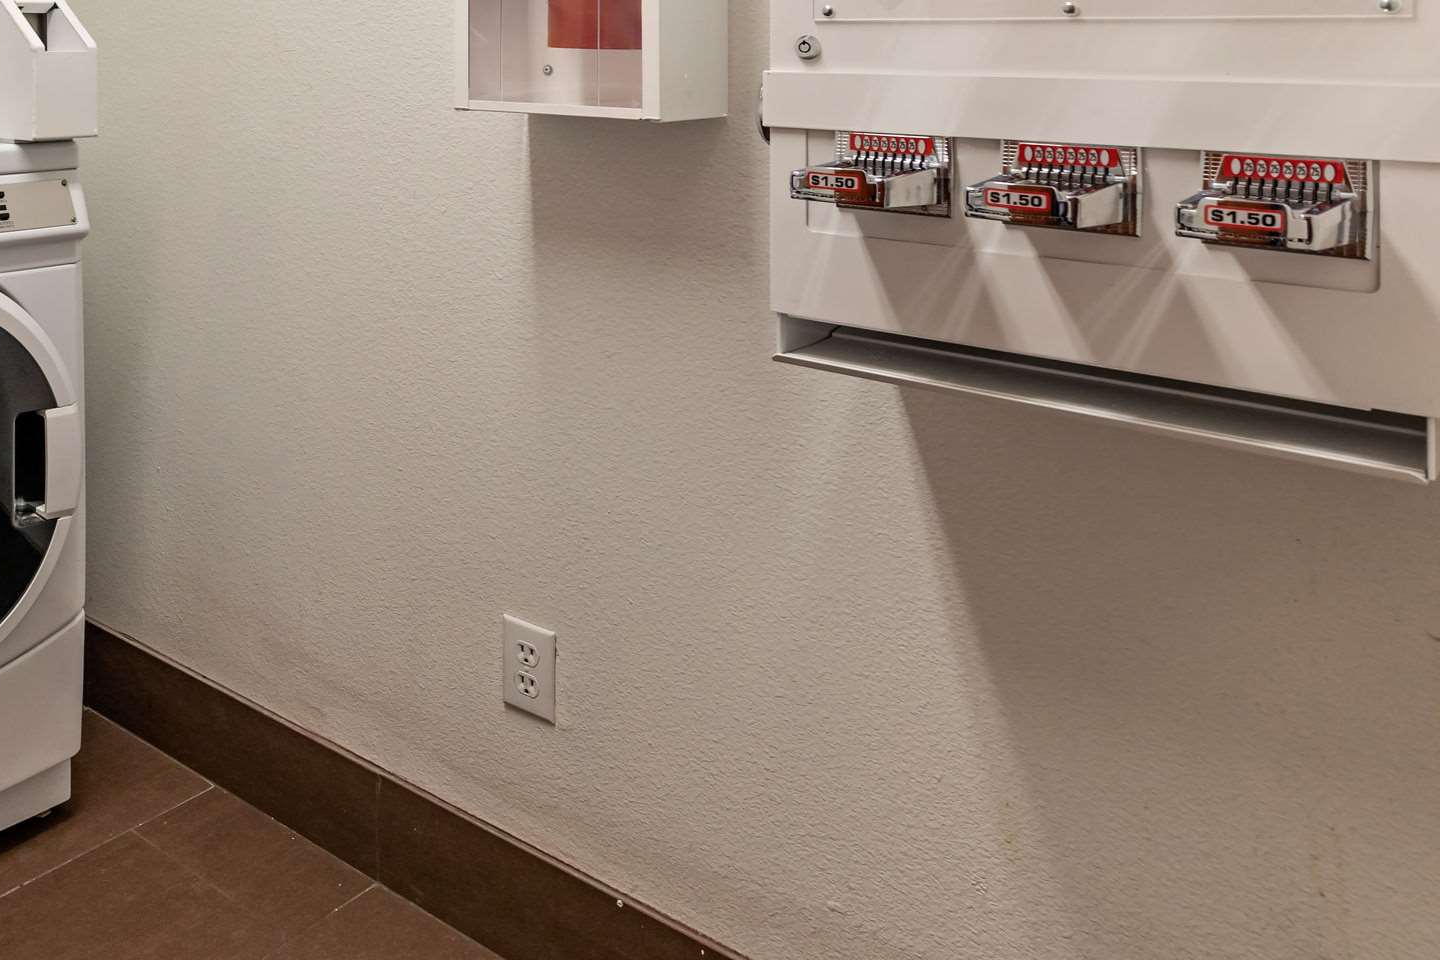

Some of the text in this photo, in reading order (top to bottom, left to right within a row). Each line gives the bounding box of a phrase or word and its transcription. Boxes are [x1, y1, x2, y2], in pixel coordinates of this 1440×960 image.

[811, 175, 855, 189] $1.50
[990, 192, 1042, 207] $1.50
[1211, 209, 1276, 227] $1.50
